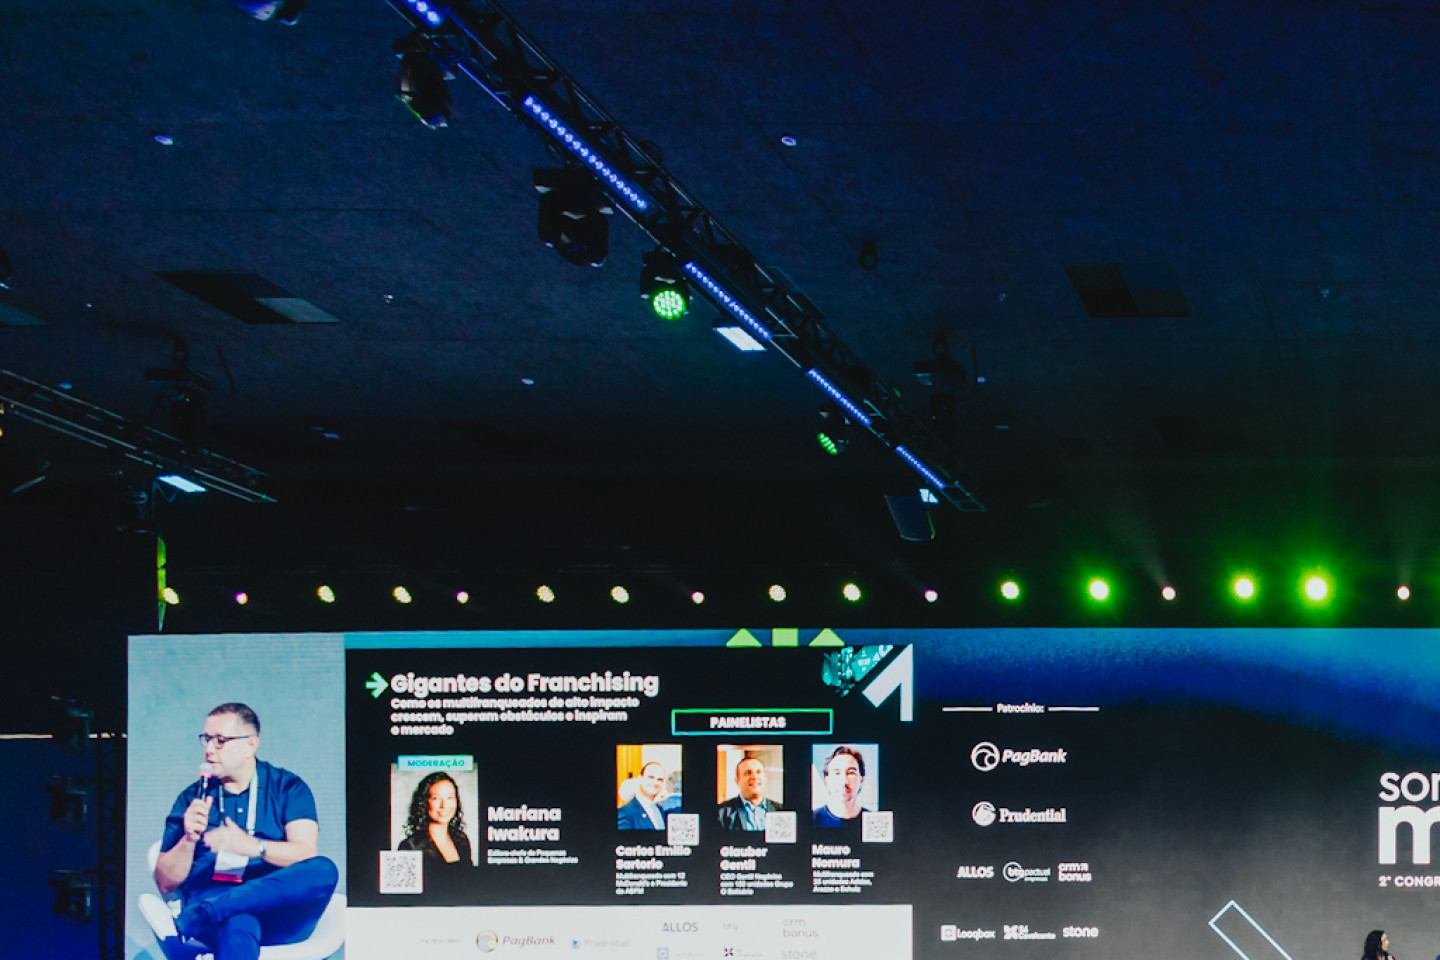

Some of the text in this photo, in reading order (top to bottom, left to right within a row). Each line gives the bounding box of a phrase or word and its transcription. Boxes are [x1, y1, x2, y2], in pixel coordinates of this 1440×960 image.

[390, 671, 659, 697] Gigantes do Franchising
[390, 698, 426, 709] Como
[590, 696, 640, 710] impacto
[575, 709, 628, 724] inspiram
[710, 716, 786, 729] PAINELISTAS
[401, 724, 454, 736] mercado
[1002, 748, 1067, 766] PagBank
[407, 758, 465, 770] MODERAÇÃO
[487, 804, 562, 822] Mariana
[1000, 808, 1067, 823] Prudential
[487, 825, 560, 841] Iwakura
[616, 845, 653, 857] Carlos
[720, 846, 768, 857] Glauber
[812, 845, 851, 856] Mauro
[812, 858, 861, 868] Nomura
[957, 866, 994, 879] ALLOS
[1058, 872, 1092, 882] bonus
[661, 921, 698, 933] ALLOS
[1062, 926, 1099, 938] stone
[502, 935, 556, 948] PagBank
